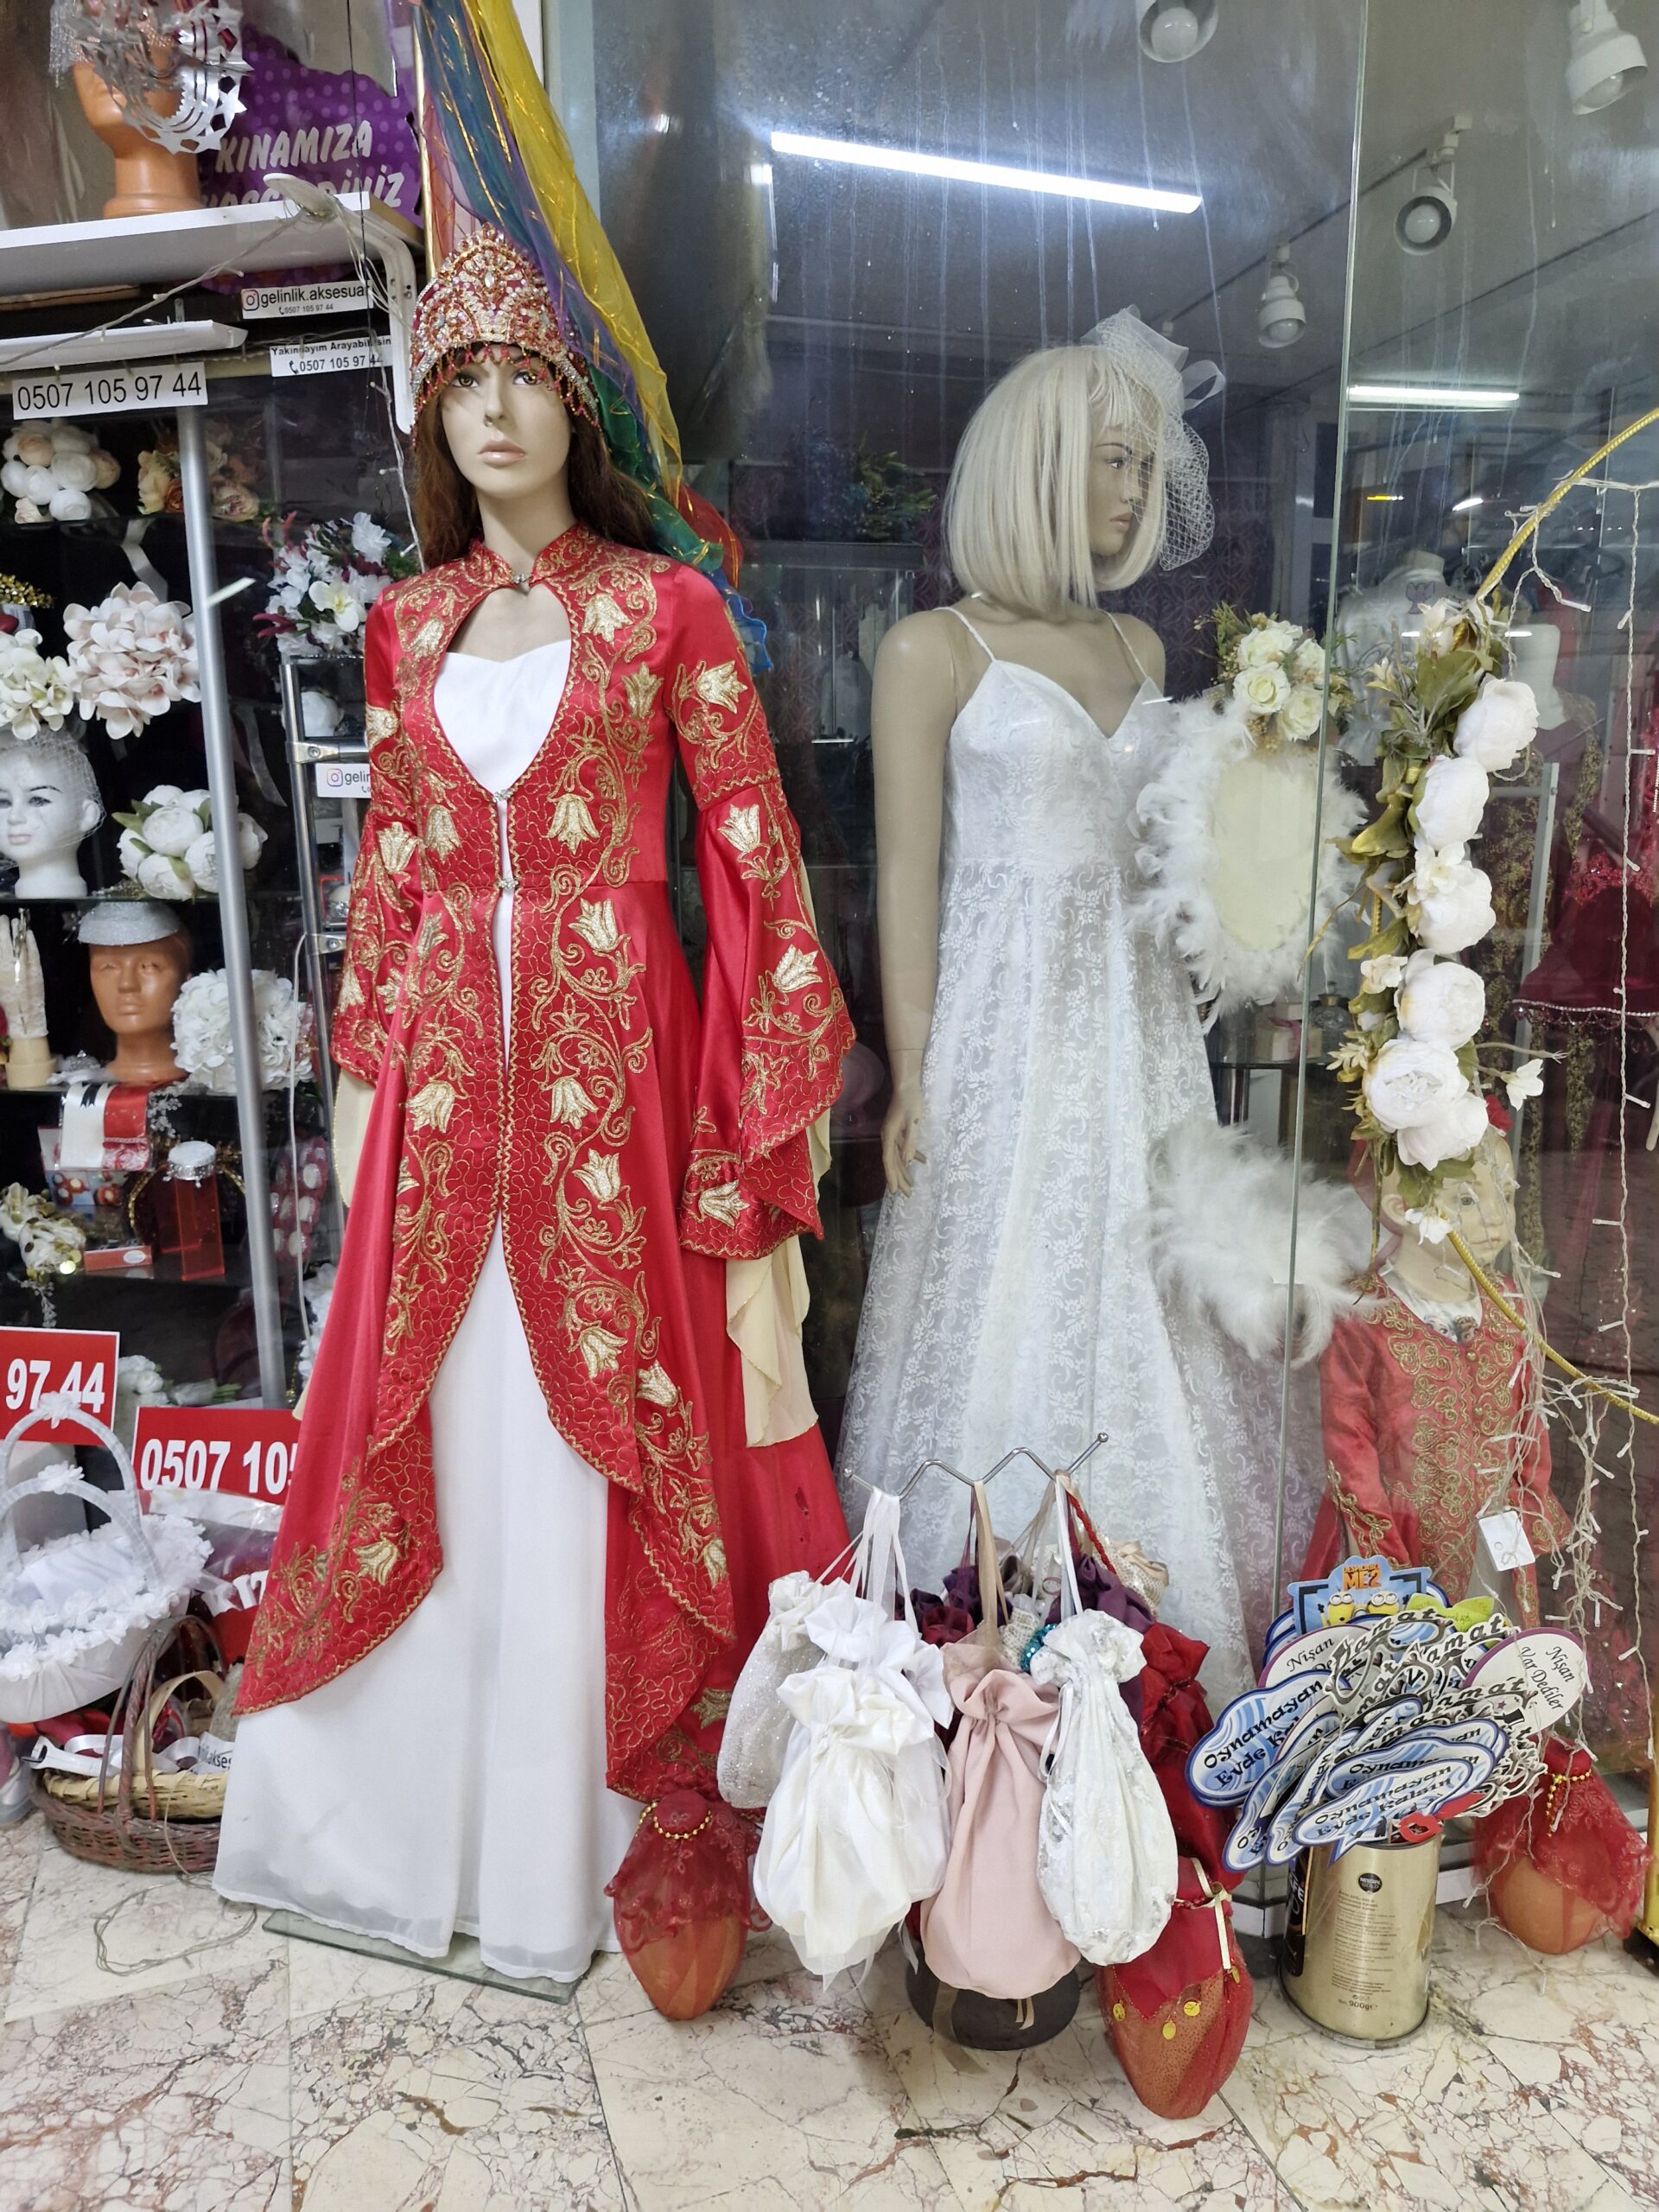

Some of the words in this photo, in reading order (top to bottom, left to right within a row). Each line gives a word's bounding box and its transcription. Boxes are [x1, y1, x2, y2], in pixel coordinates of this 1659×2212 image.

[216, 120, 372, 173] KINAMIZA
[271, 345, 327, 356] Yakınayım
[299, 359, 326, 372] 0507
[329, 356, 350, 369] 105
[353, 355, 365, 367] 97
[17, 382, 73, 411] 0507
[84, 378, 127, 405] 105
[134, 374, 162, 401] 97
[172, 371, 202, 397] 44
[5, 1357, 52, 1411] 97
[59, 1361, 105, 1414] 44
[140, 1438, 231, 1492] 0507
[243, 1440, 298, 1496] 10
[1286, 1638, 1335, 1672] Nişan
[1546, 1646, 1575, 1683] Nişan
[1531, 1669, 1565, 1710] Dediler
[1204, 1680, 1323, 1769] Oynamayan
[1214, 1747, 1267, 1788] Evde
[1314, 1765, 1452, 1826] Oynamayan
[1317, 1811, 1372, 1837] Evde
